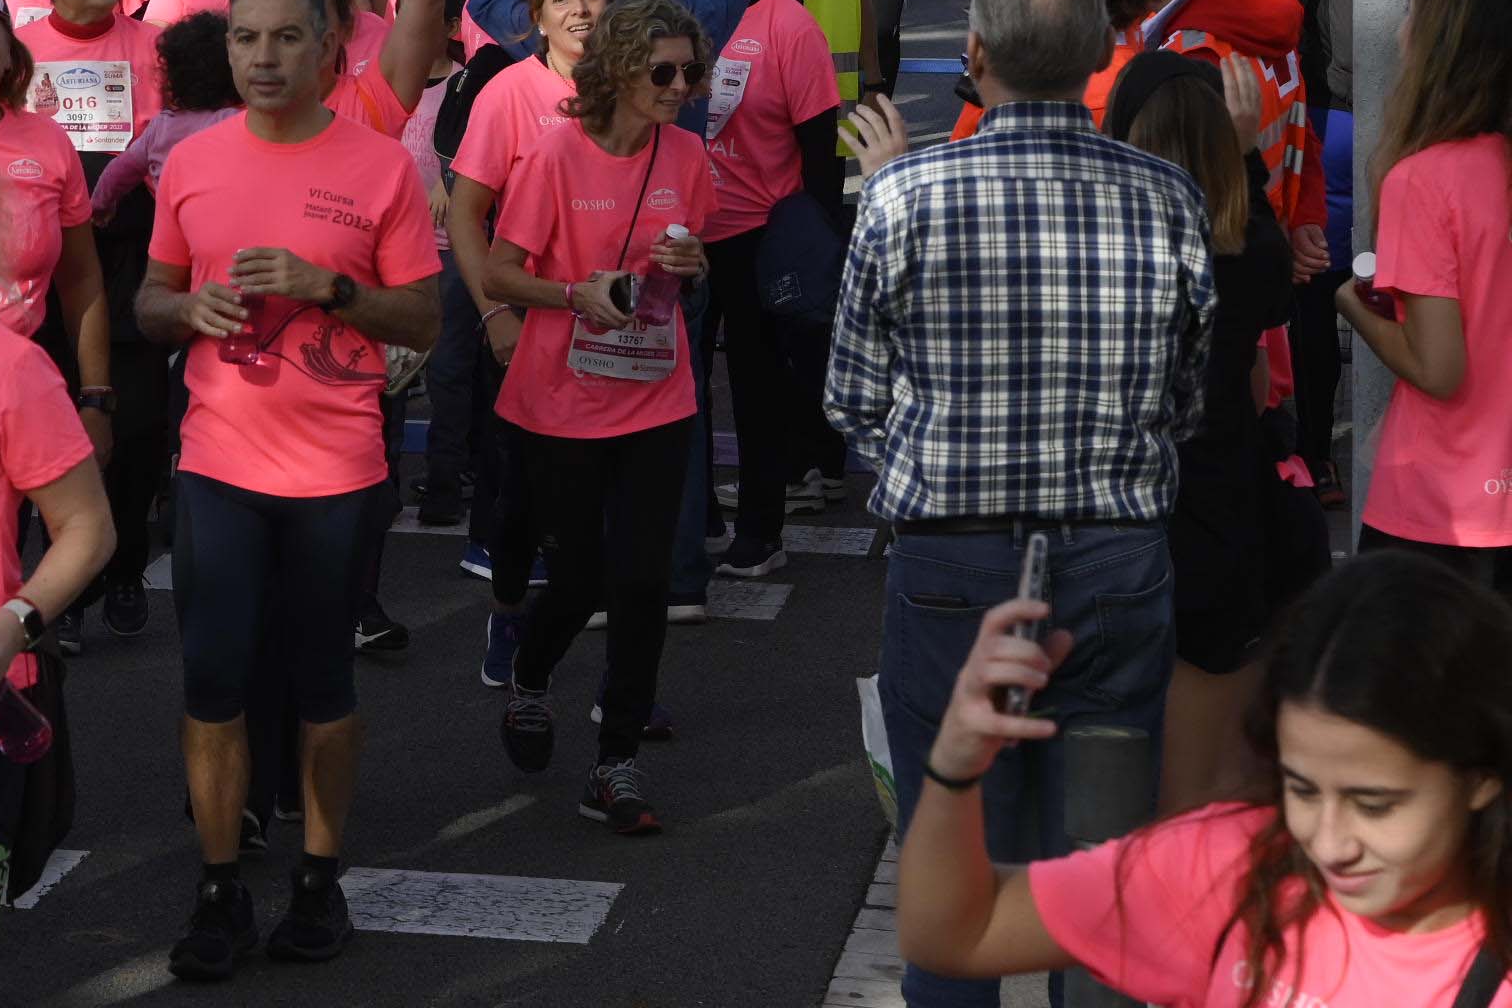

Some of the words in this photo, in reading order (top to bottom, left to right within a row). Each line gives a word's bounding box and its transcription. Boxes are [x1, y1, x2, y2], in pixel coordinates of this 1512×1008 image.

[59, 76, 98, 86] ASTURIANA
[62, 96, 97, 110] 016
[66, 113, 94, 122] 30979
[94, 136, 125, 144] Santander
[309, 187, 321, 199] VI
[323, 191, 354, 207] Cursa
[571, 199, 616, 210] OYSHO
[332, 209, 374, 232] 2012
[579, 355, 614, 369] OYSHO
